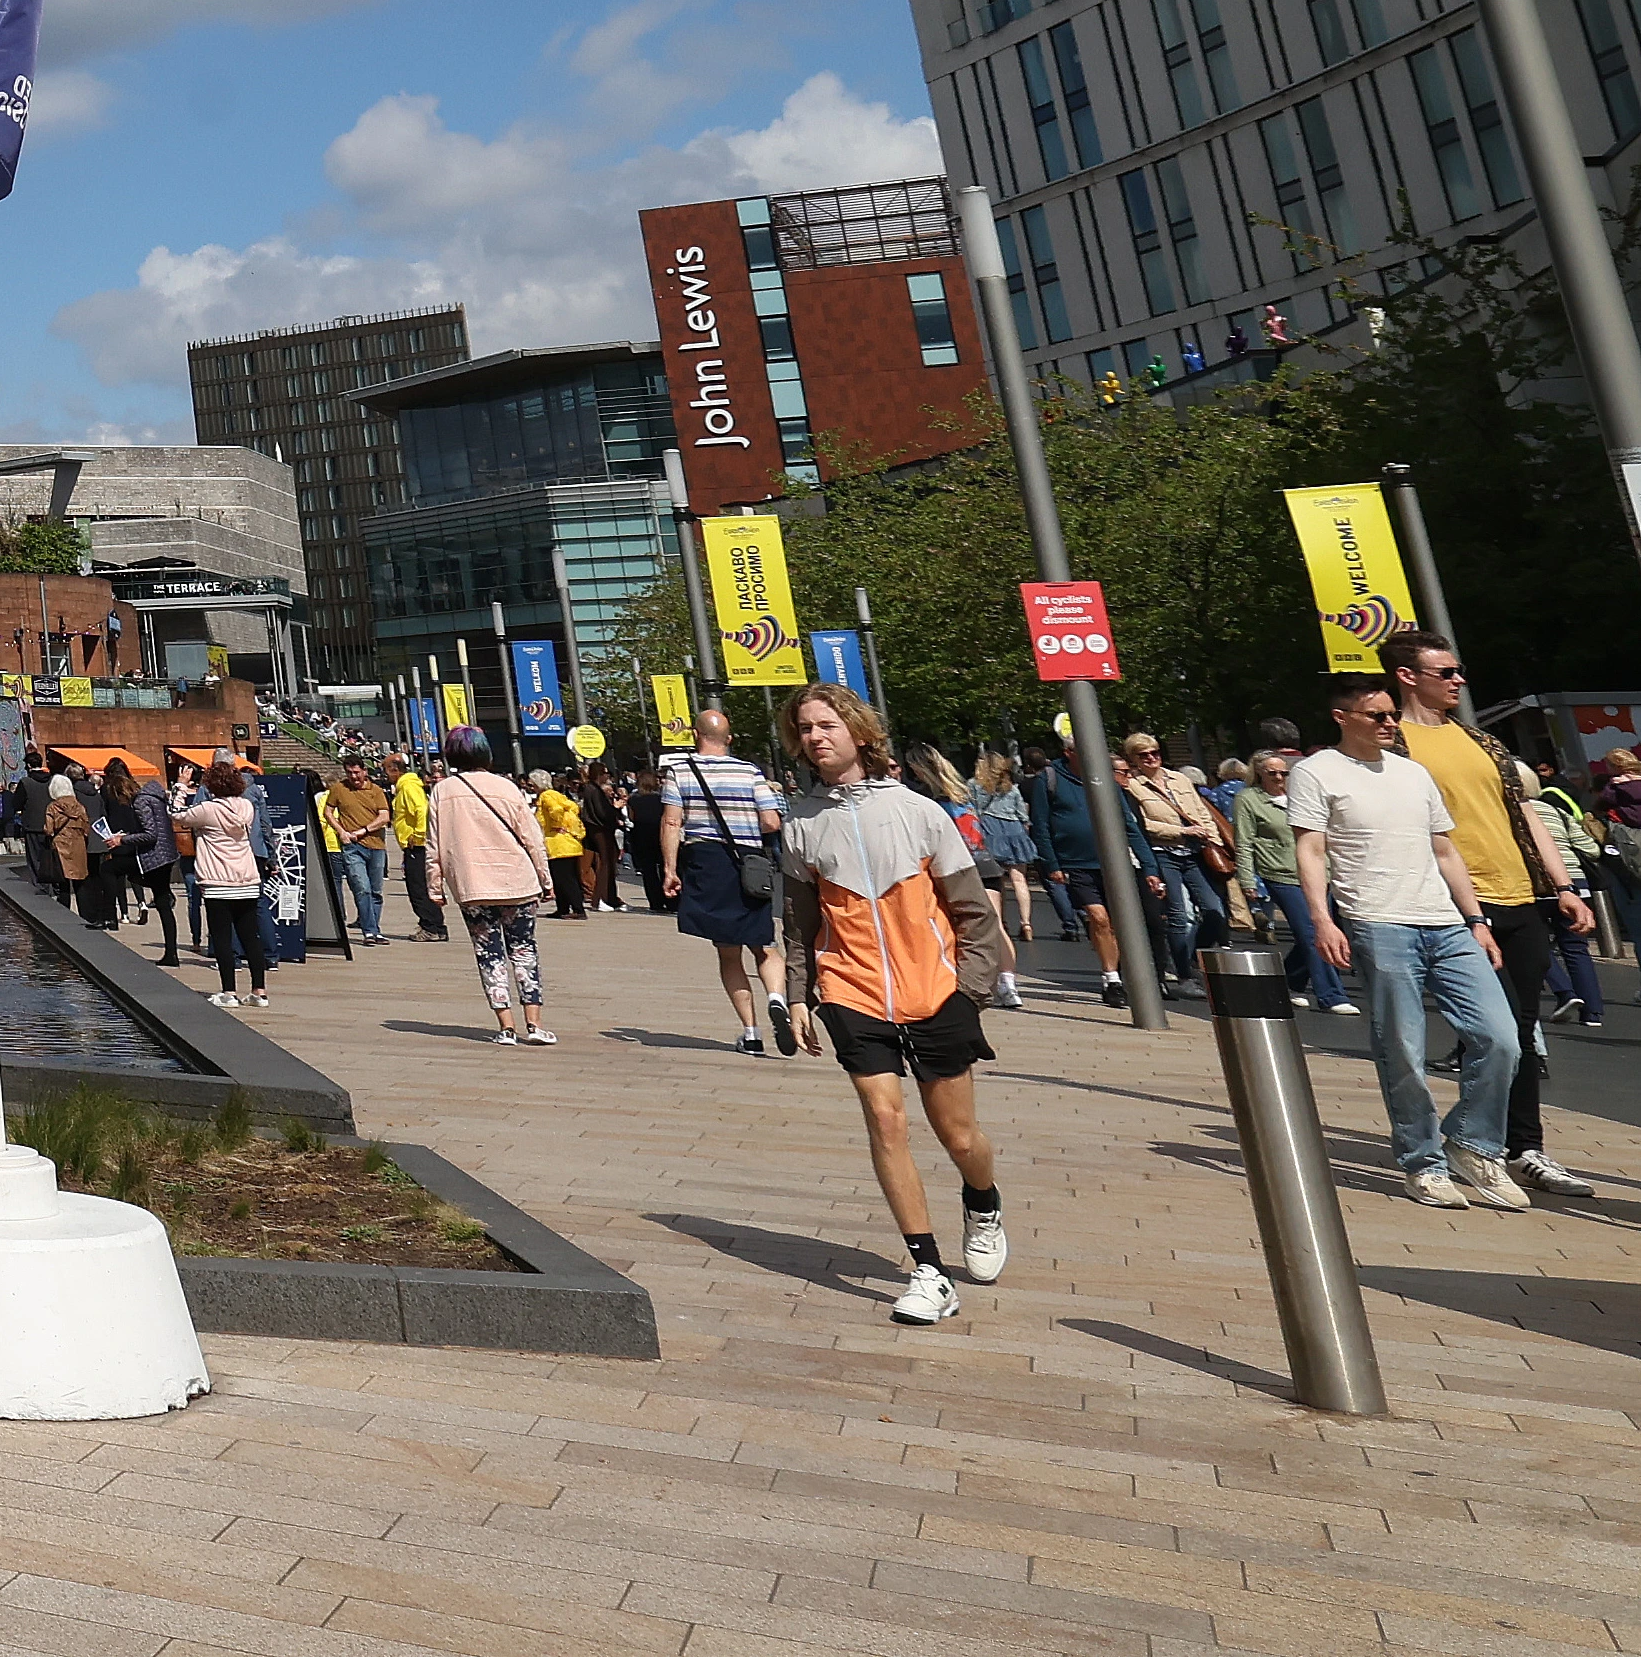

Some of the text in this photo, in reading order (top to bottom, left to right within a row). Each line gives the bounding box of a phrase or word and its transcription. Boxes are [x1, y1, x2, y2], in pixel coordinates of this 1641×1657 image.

[666, 246, 751, 449] John Lewis
[1333, 517, 1370, 596] WELCOME
[166, 582, 221, 594] TERRACE
[731, 547, 753, 611] ЛАСКАВО
[746, 545, 769, 611] ПРОСИМО
[1034, 594, 1093, 606] All cyclists
[1046, 606, 1084, 615] please
[1041, 615, 1094, 625] dismount
